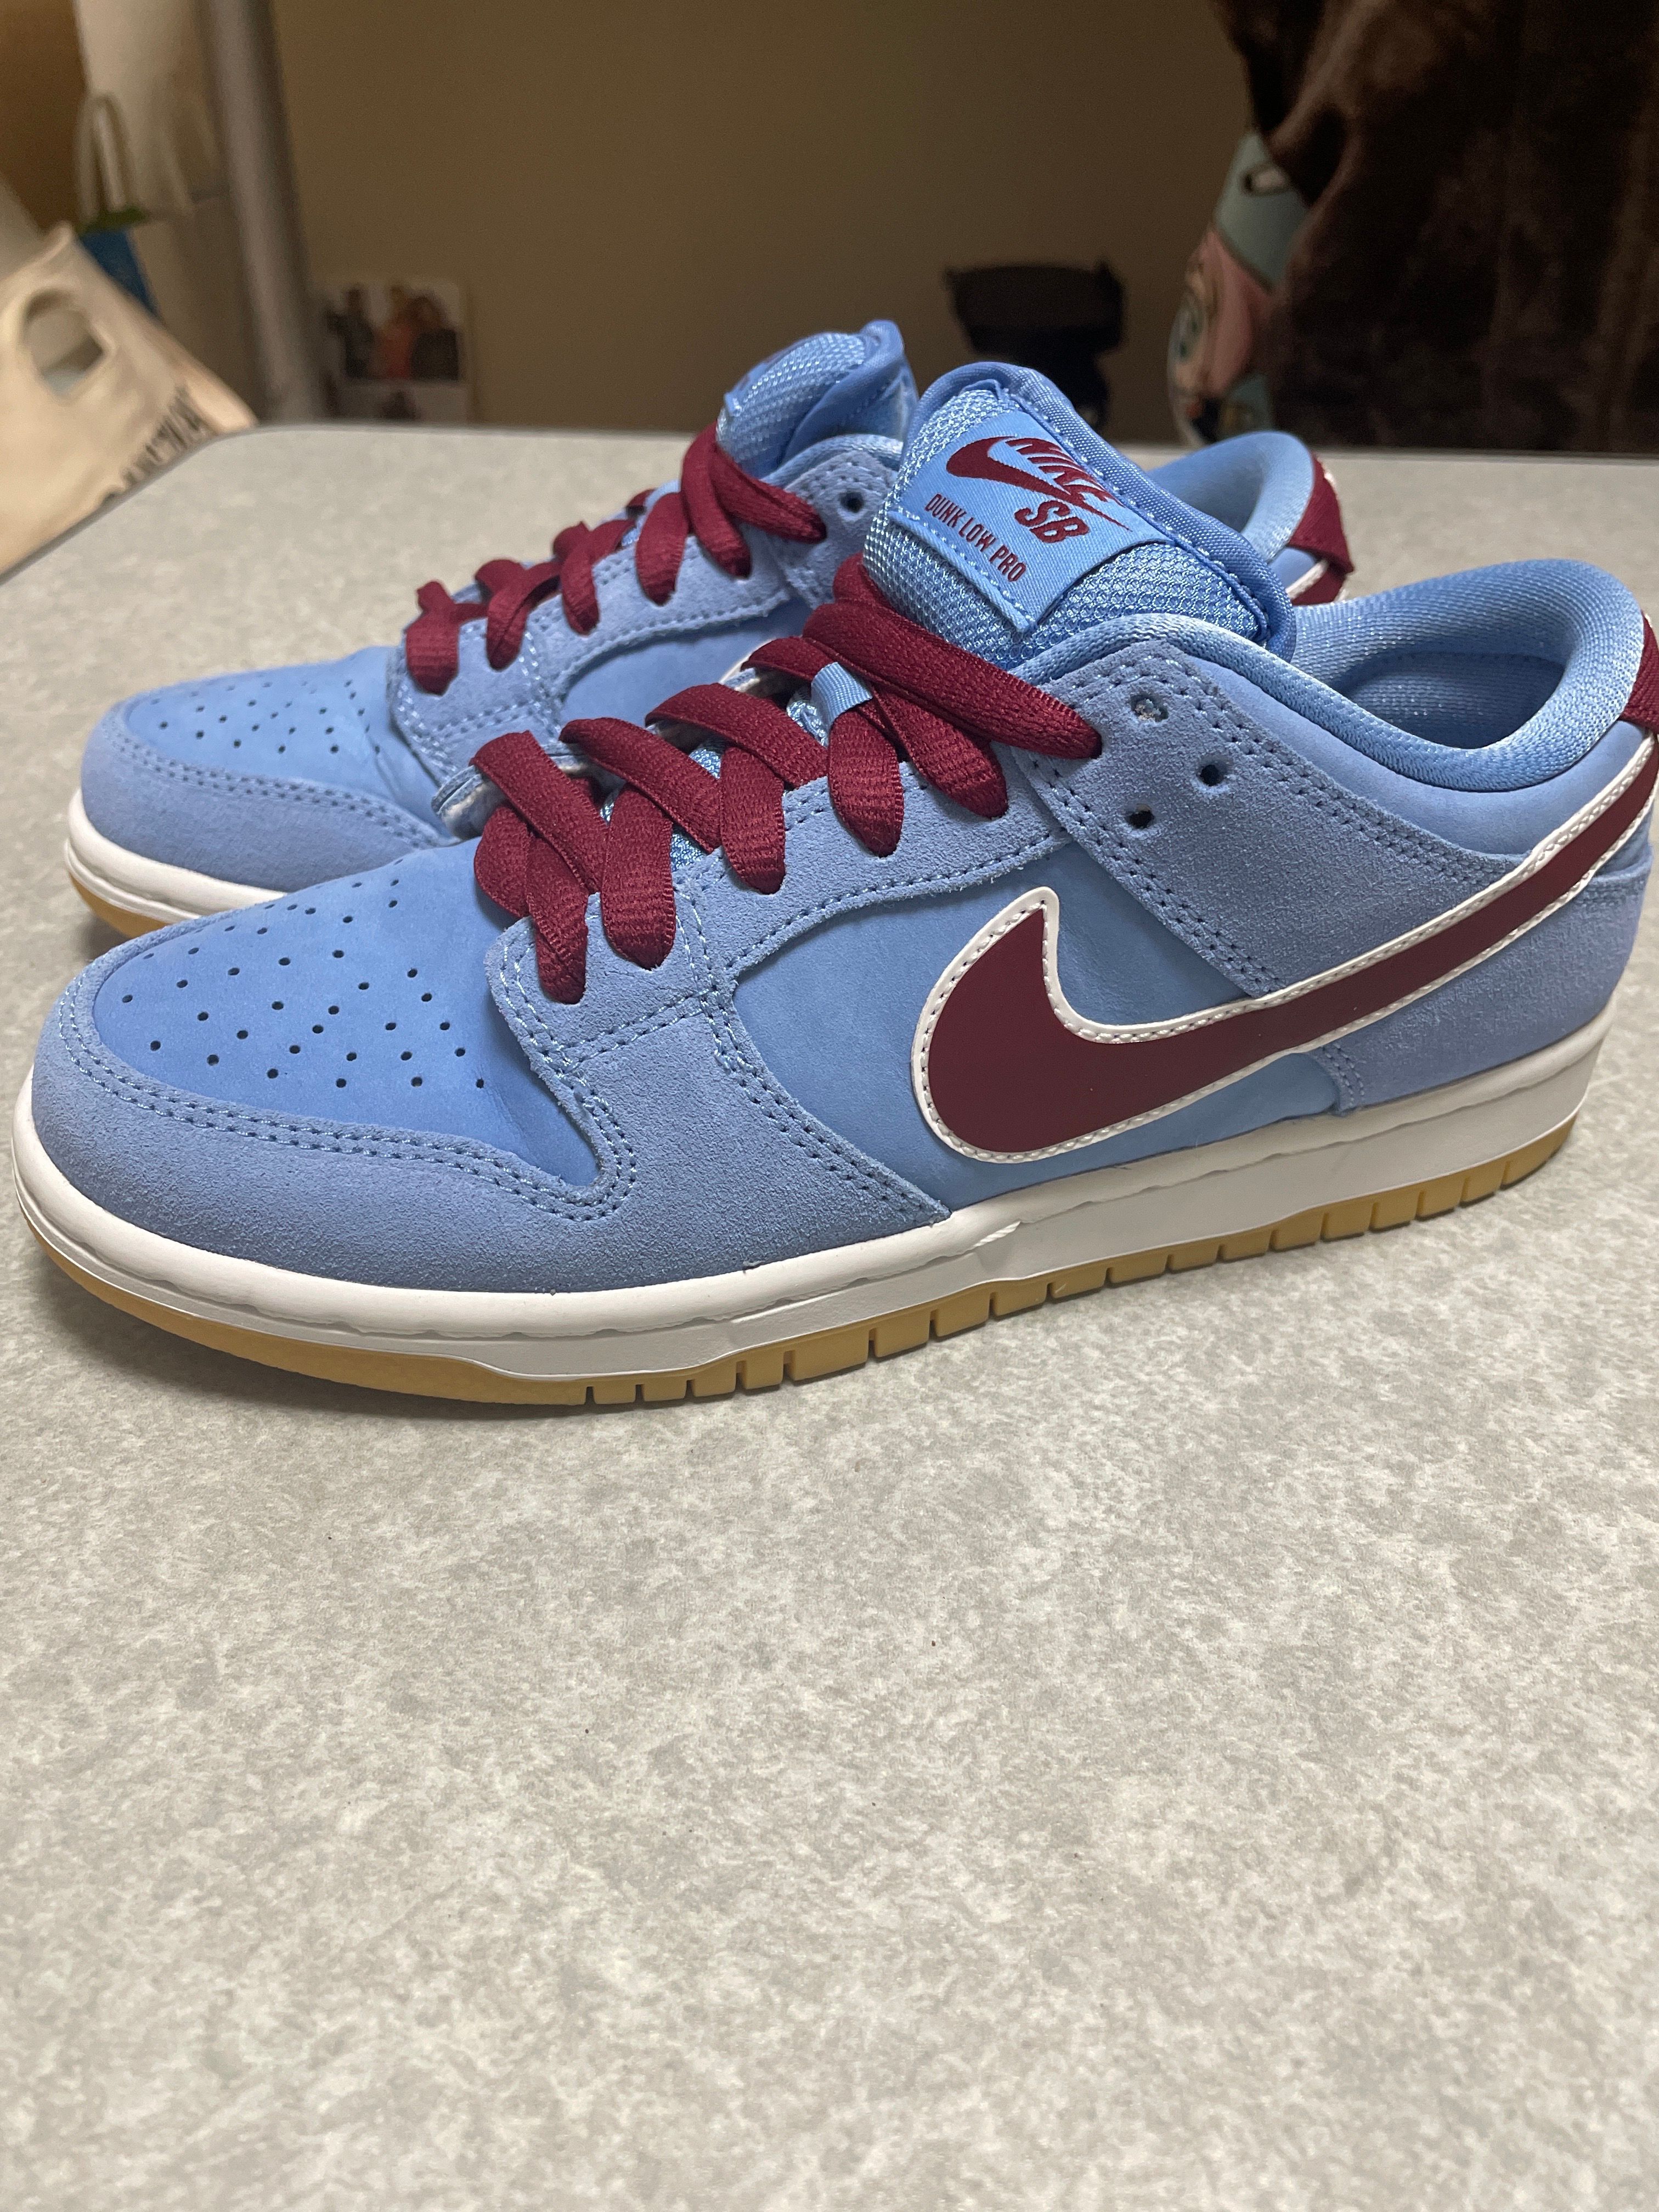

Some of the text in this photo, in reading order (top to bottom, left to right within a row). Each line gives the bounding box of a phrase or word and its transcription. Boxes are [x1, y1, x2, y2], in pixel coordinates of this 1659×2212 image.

[1005, 437, 1127, 508] NIKE
[924, 493, 1027, 582] DUNK LOW PRO
[1014, 500, 1090, 543] SB
